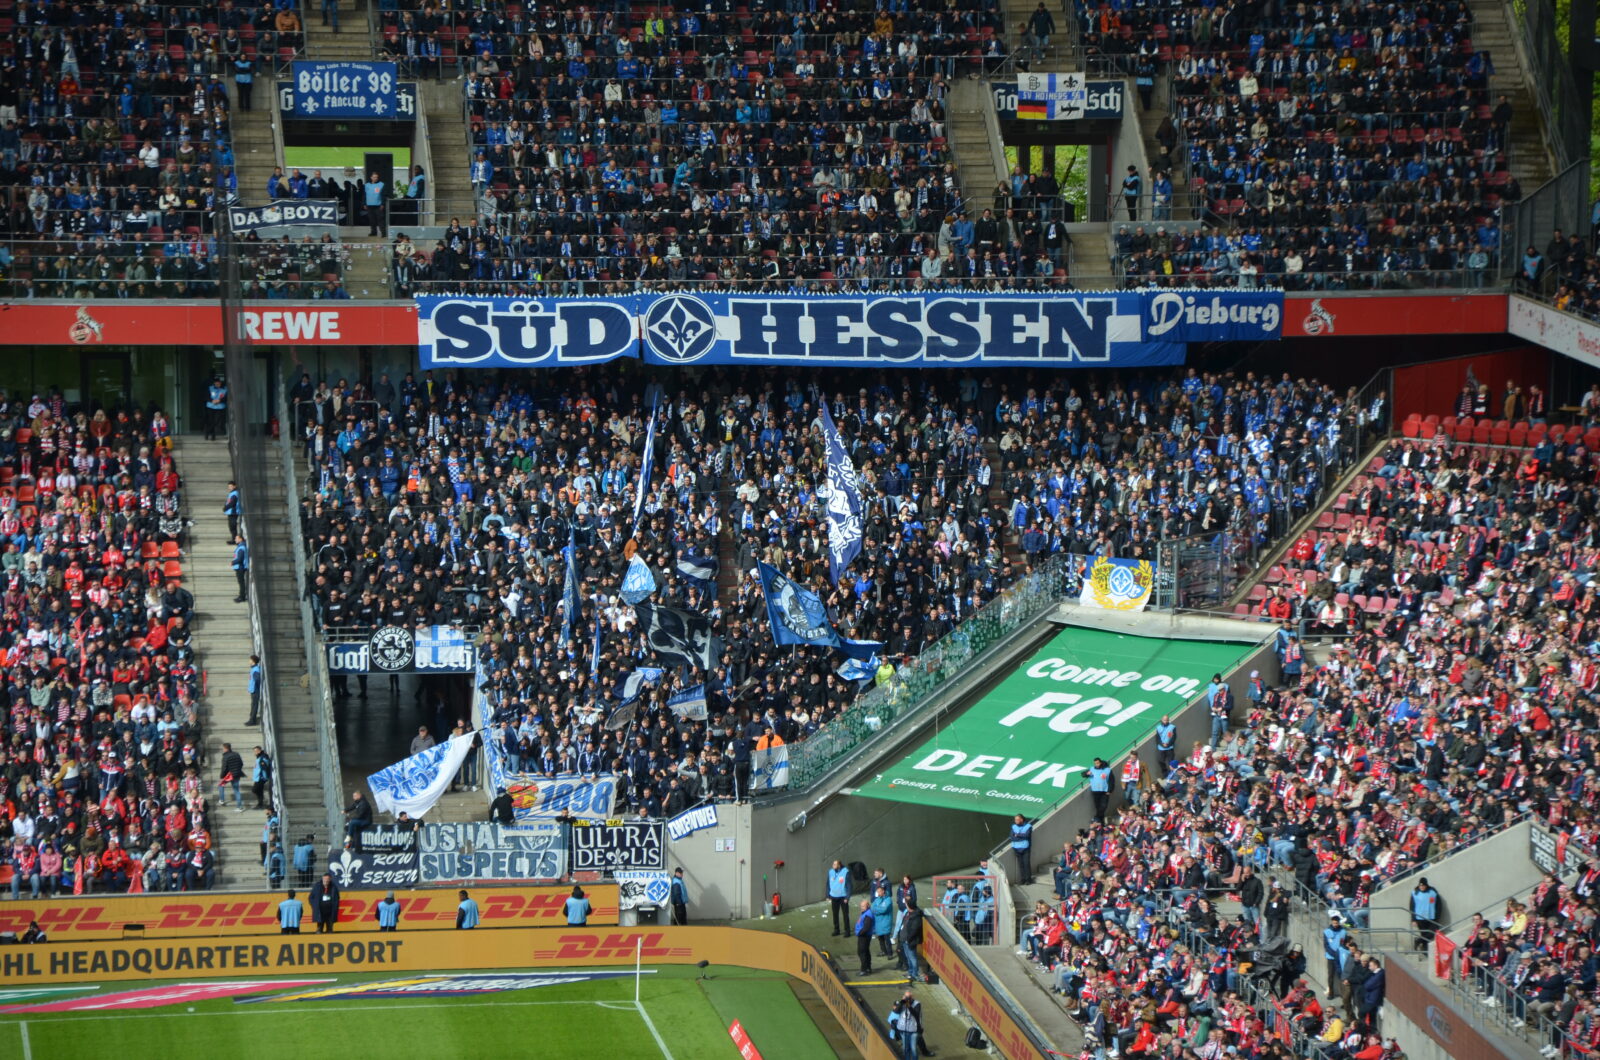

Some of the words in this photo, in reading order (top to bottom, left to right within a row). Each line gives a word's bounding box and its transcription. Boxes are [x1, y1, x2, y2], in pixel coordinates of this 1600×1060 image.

[299, 70, 361, 93] Böller
[367, 72, 392, 94] 98
[233, 212, 260, 226] DA
[283, 206, 334, 220] BOYZ
[237, 312, 341, 340] REWE
[431, 299, 633, 363] SÜD
[728, 297, 1117, 363] HESSEN
[1148, 292, 1280, 336] Dieburg
[1026, 657, 1142, 687] Come
[1140, 675, 1200, 699] on,
[998, 692, 1153, 737] FC!
[913, 749, 1090, 788] DEVK
[540, 781, 614, 814] 1898
[891, 778, 937, 790] Gesagt.
[942, 785, 980, 795] Getan.
[986, 790, 1045, 803] Geholfen.
[373, 852, 414, 866] ROW
[421, 850, 558, 881] SUSPECTS
[577, 848, 606, 867] DE
[630, 847, 660, 866] LIS
[361, 868, 418, 884] SEVEN
[158, 902, 277, 929] DHL
[0, 952, 42, 977] HL
[50, 944, 270, 974] HEADQUARTER
[276, 940, 403, 967] AIRPORT
[554, 932, 670, 959] DHL
[927, 930, 947, 975] DHL
[953, 962, 974, 1006] DHL
[981, 995, 1003, 1043] DHL
